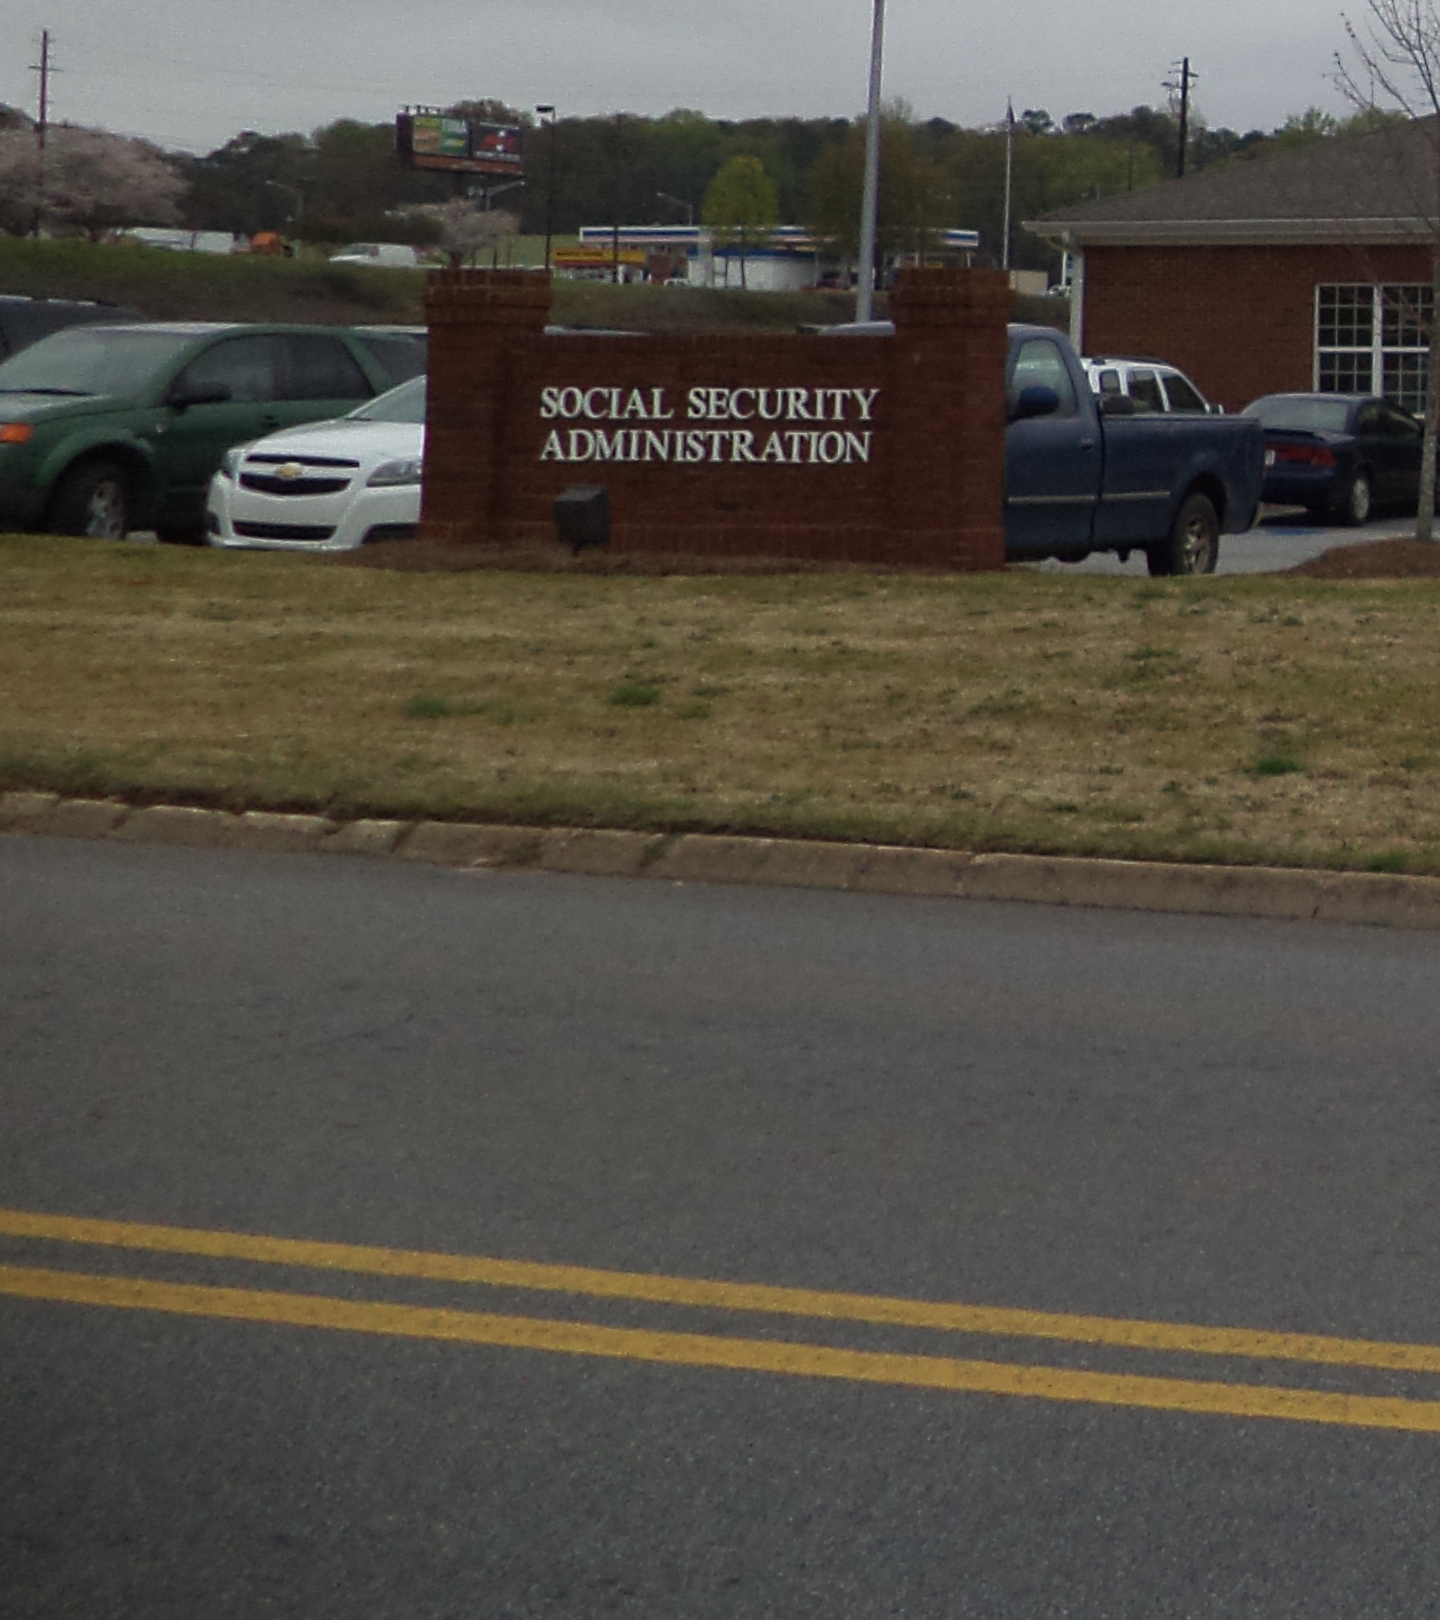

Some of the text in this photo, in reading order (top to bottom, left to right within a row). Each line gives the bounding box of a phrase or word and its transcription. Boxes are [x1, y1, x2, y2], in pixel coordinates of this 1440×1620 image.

[540, 386, 880, 421] SOCIAL SECURITY
[539, 428, 872, 464] ADMINISTRATION
